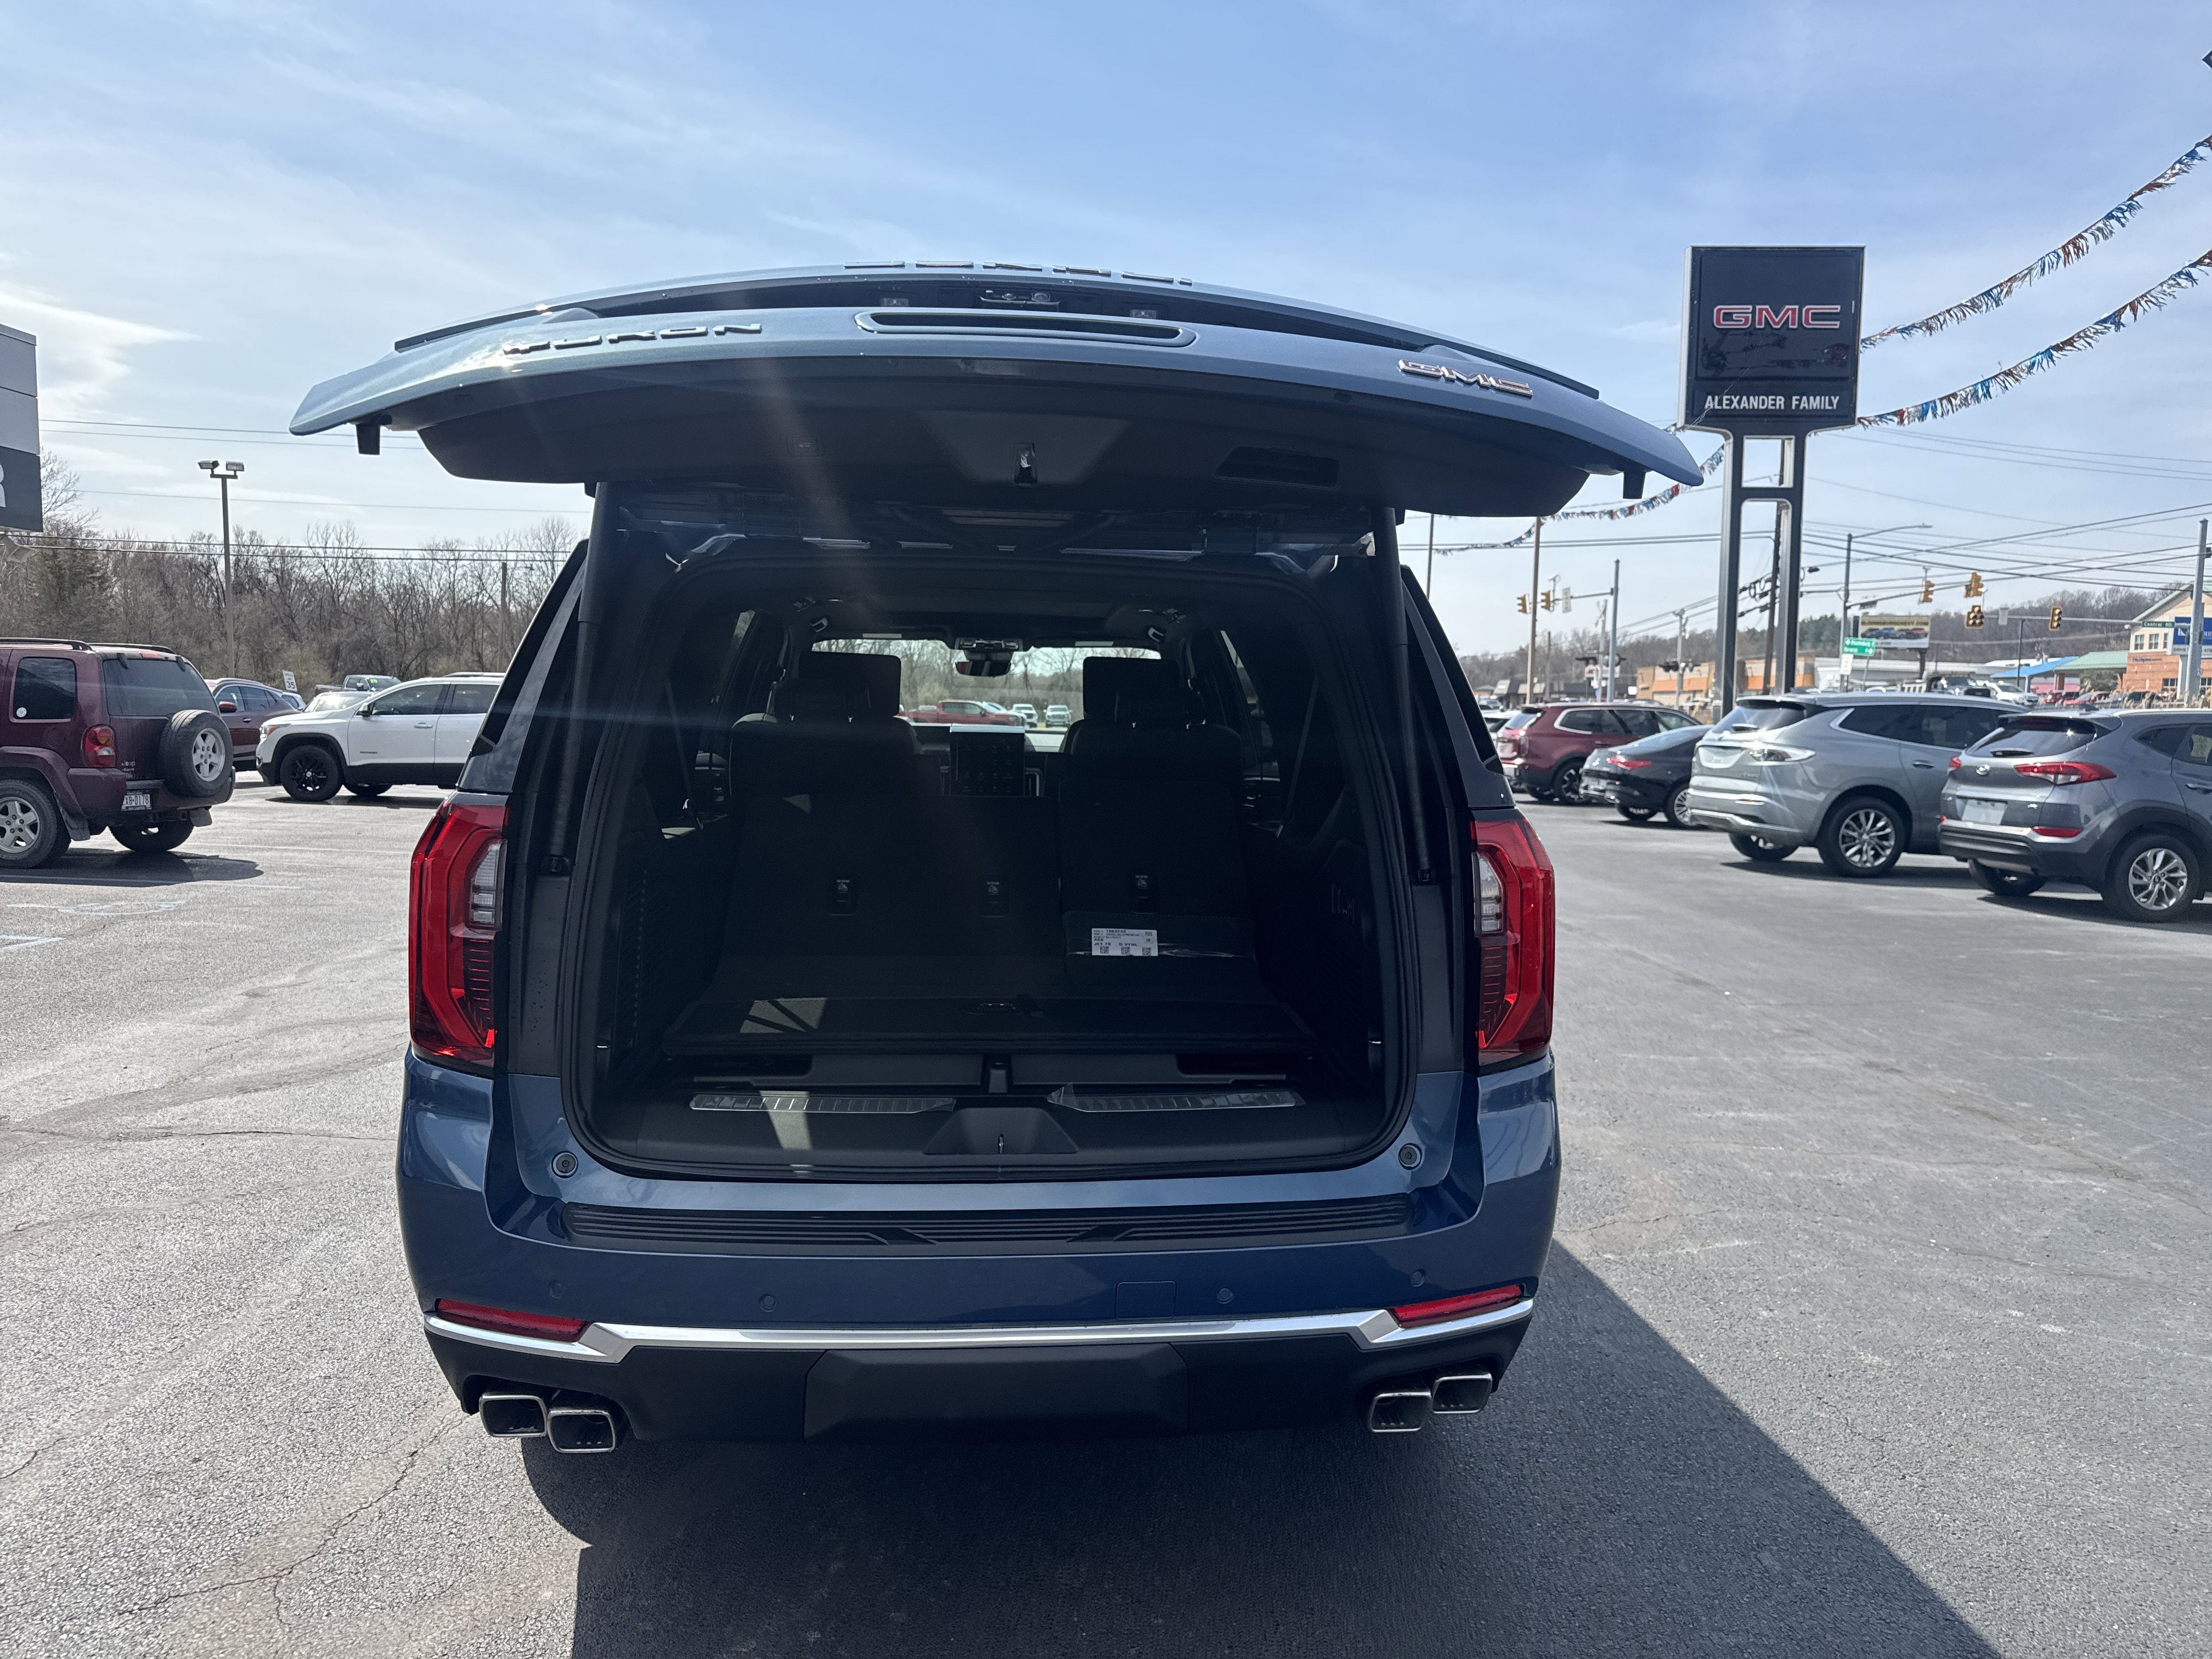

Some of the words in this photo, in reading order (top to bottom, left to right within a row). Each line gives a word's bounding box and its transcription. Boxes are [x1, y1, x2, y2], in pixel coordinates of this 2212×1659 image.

[1713, 304, 1841, 329] GMC
[1398, 359, 1533, 397] GMC
[1705, 395, 1785, 410] ALEXANDER
[1792, 395, 1840, 410] FAMILY
[286, 681, 296, 690] 35
